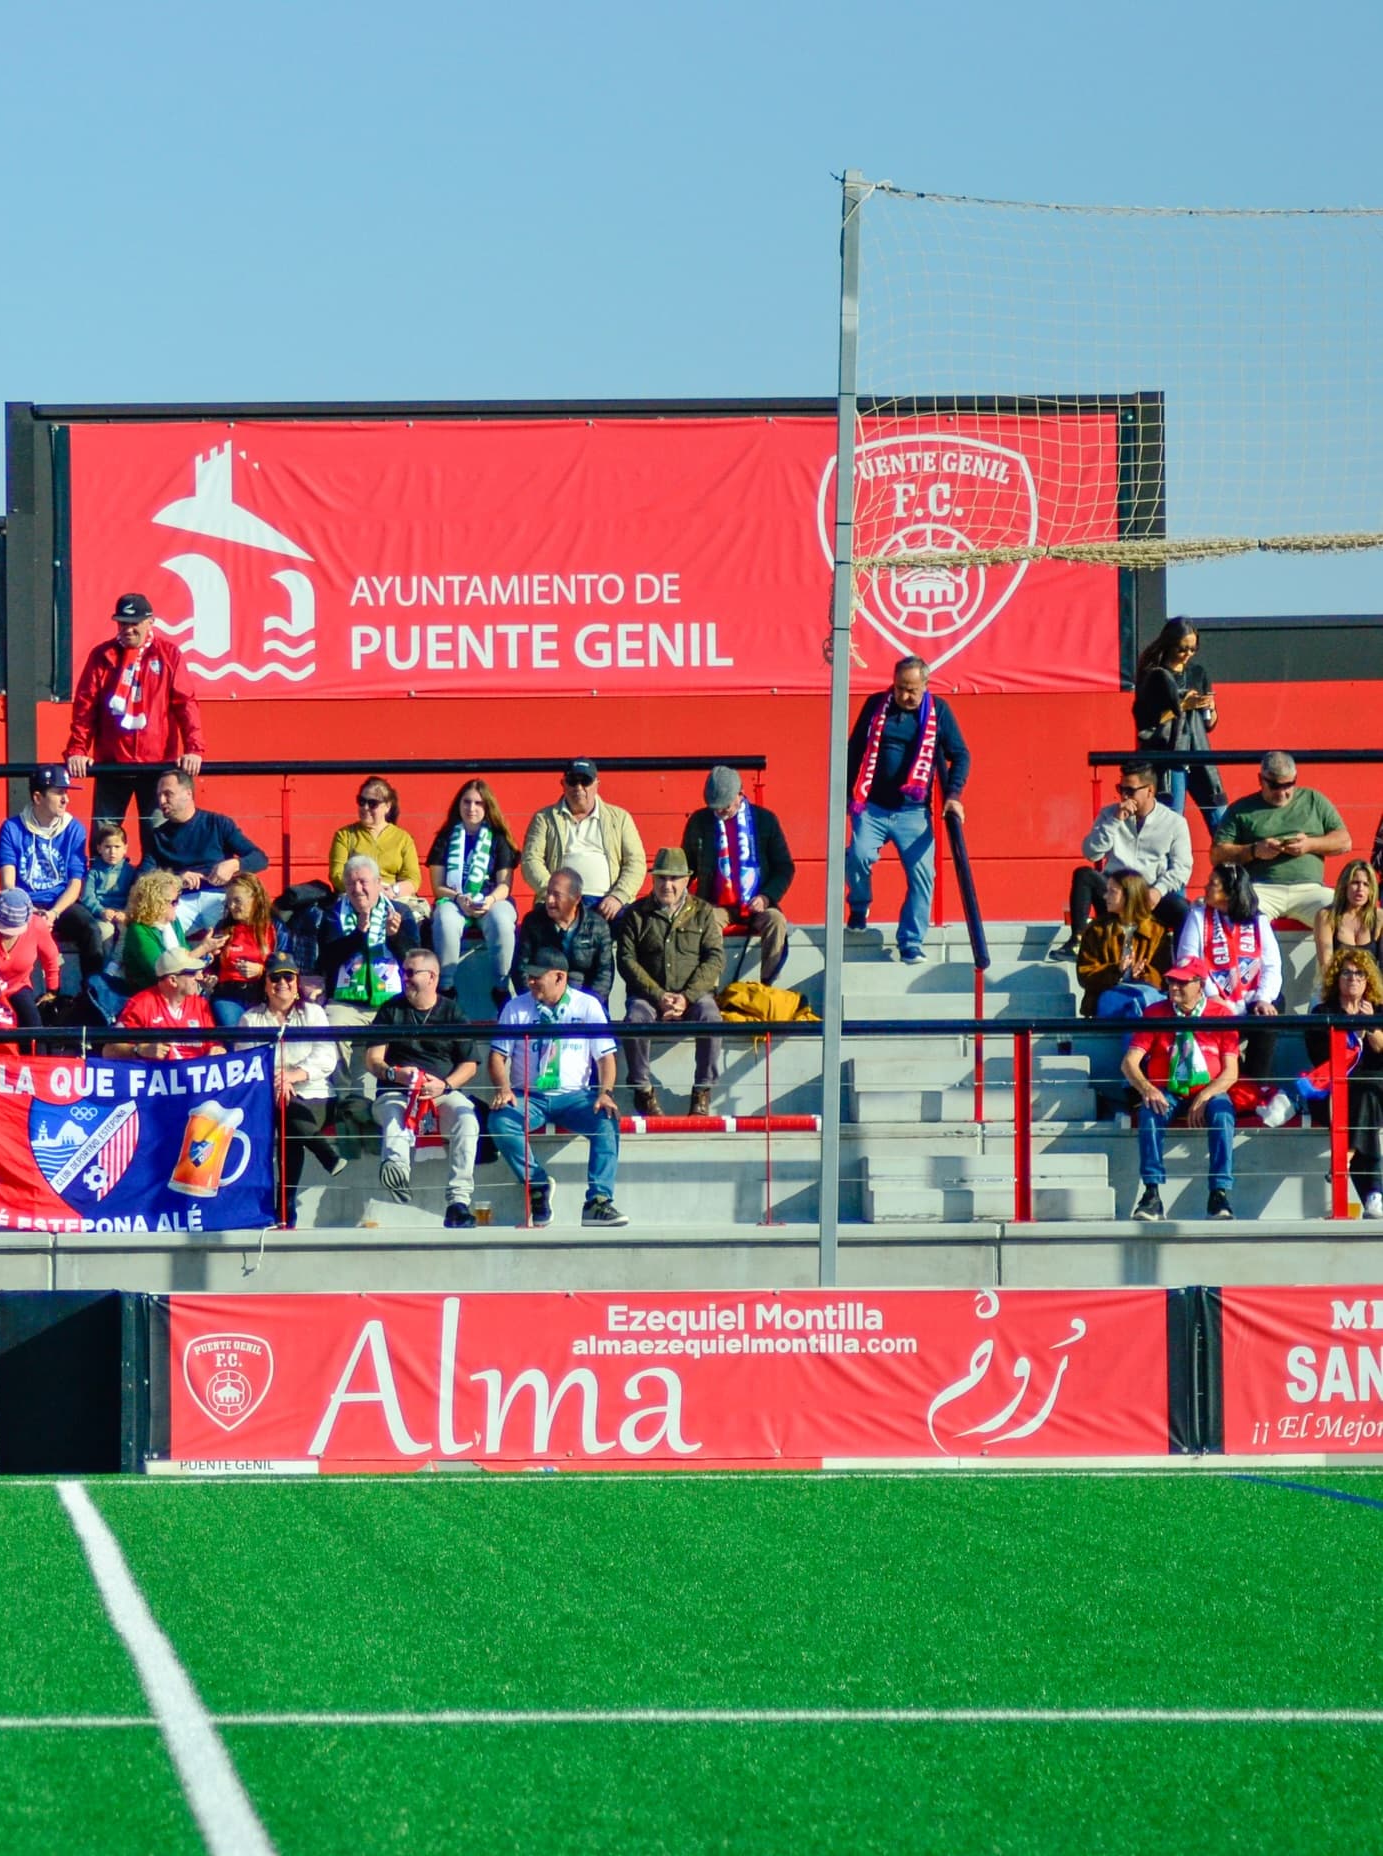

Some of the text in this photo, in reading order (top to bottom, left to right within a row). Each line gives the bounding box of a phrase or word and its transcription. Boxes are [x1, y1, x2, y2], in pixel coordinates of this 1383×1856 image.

[854, 452, 1010, 485] UENTE GENIL
[892, 482, 964, 517] F.C.
[349, 573, 681, 607] AYUNTAMIENTO DE
[351, 622, 734, 671] PUENTE GENIL
[50, 1067, 115, 1097] QUE
[129, 1056, 265, 1097] FALTABA
[156, 1203, 204, 1232] ALÉ
[607, 1302, 883, 1335] Ezequiel Montilla
[194, 1341, 232, 1356] PUENTE
[571, 1333, 917, 1359] almaezequielmontilla.com
[307, 1297, 703, 1456] Alma
[1285, 1345, 1383, 1404] SAN
[1277, 1412, 1314, 1439] El
